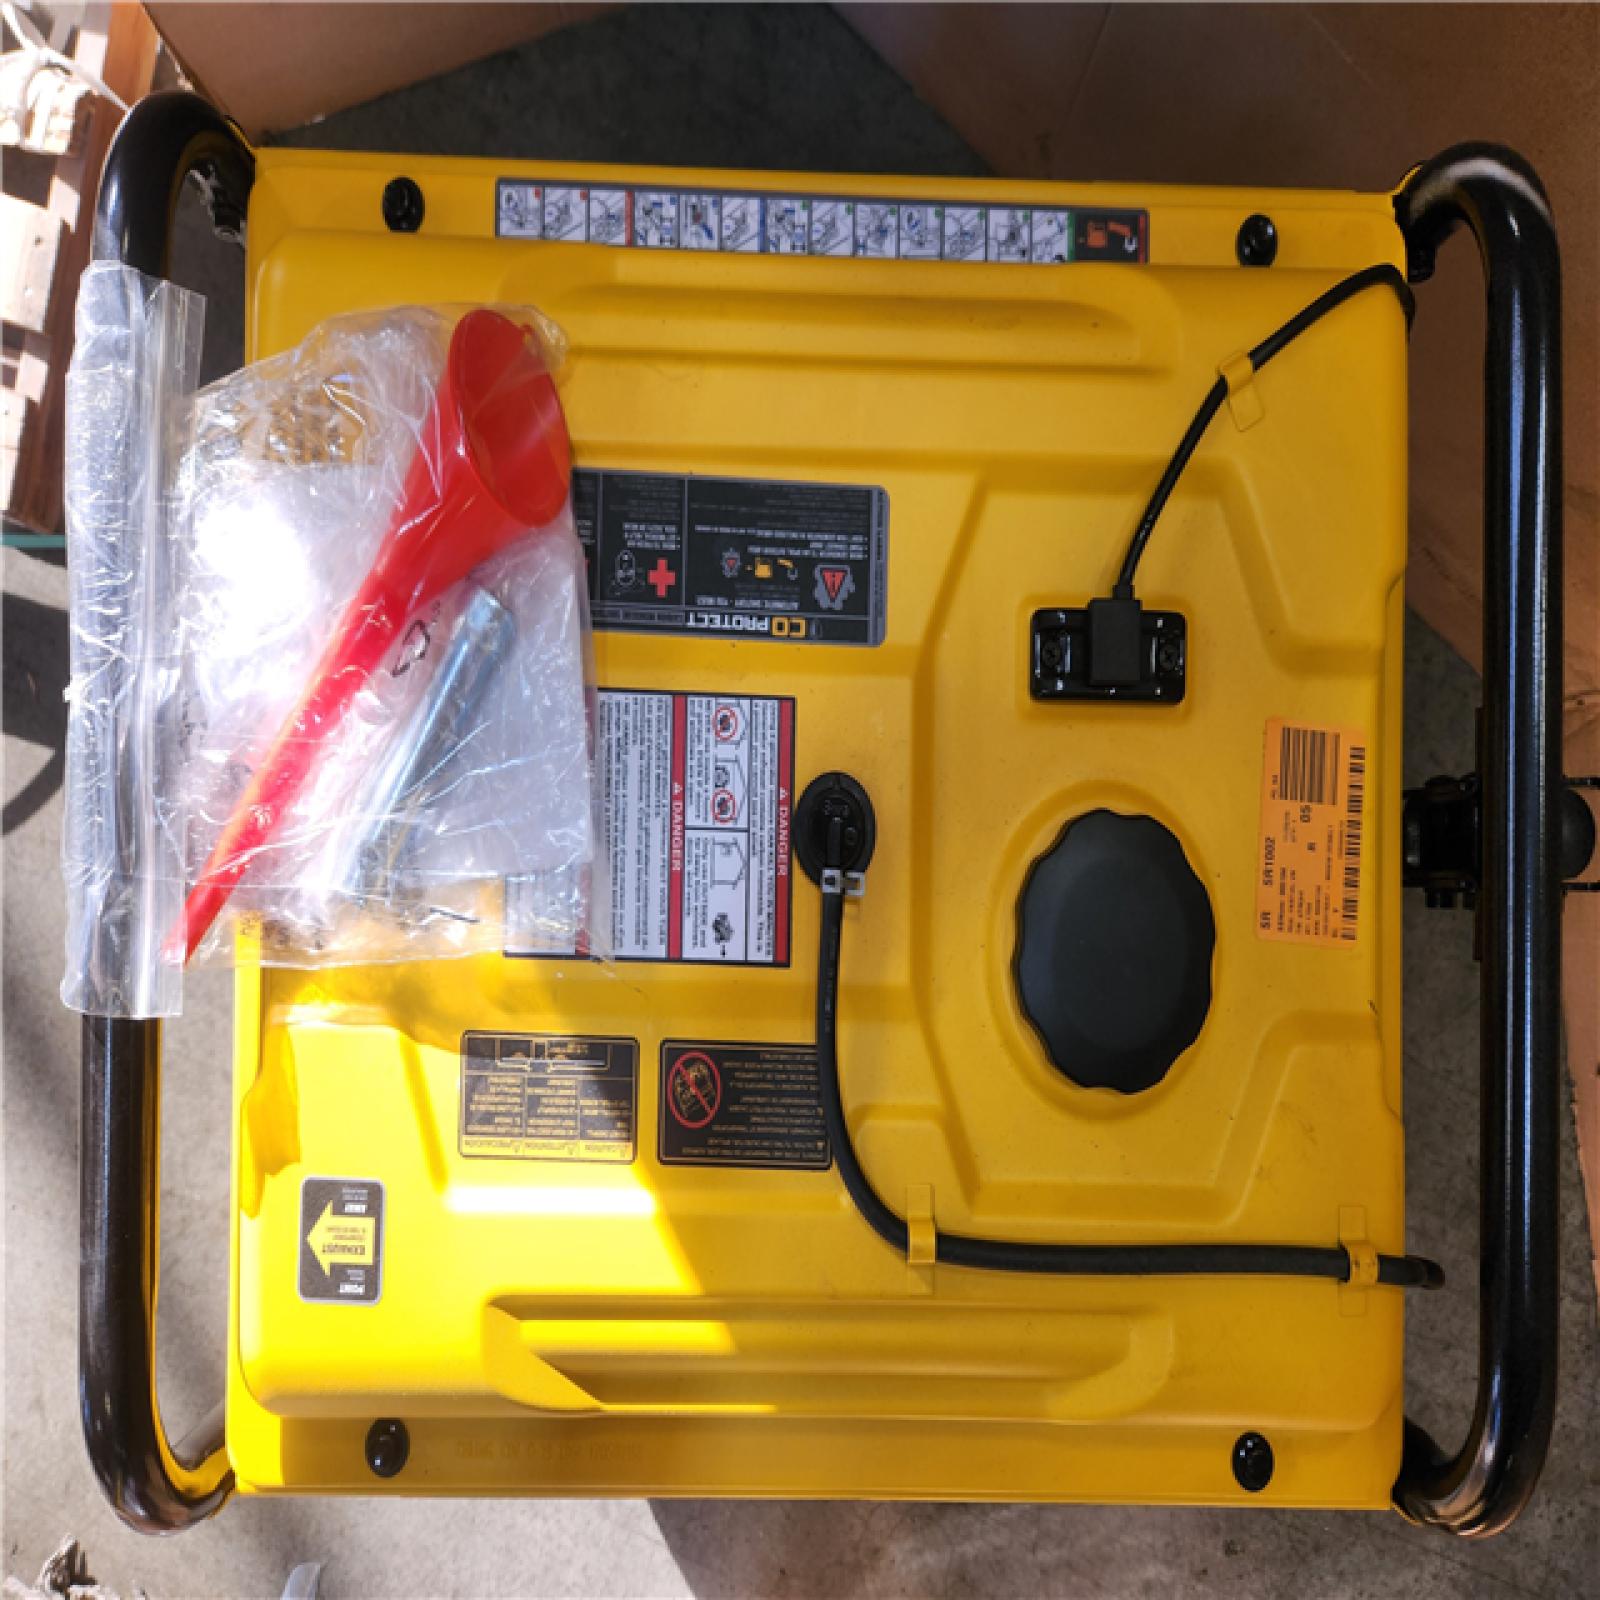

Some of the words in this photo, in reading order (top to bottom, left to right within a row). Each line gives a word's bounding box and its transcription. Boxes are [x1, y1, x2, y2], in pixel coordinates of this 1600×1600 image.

[686, 613, 769, 631] PROTECT
[770, 617, 806, 638] CO
[671, 800, 683, 871] DANGER
[777, 805, 788, 877] DANGER
